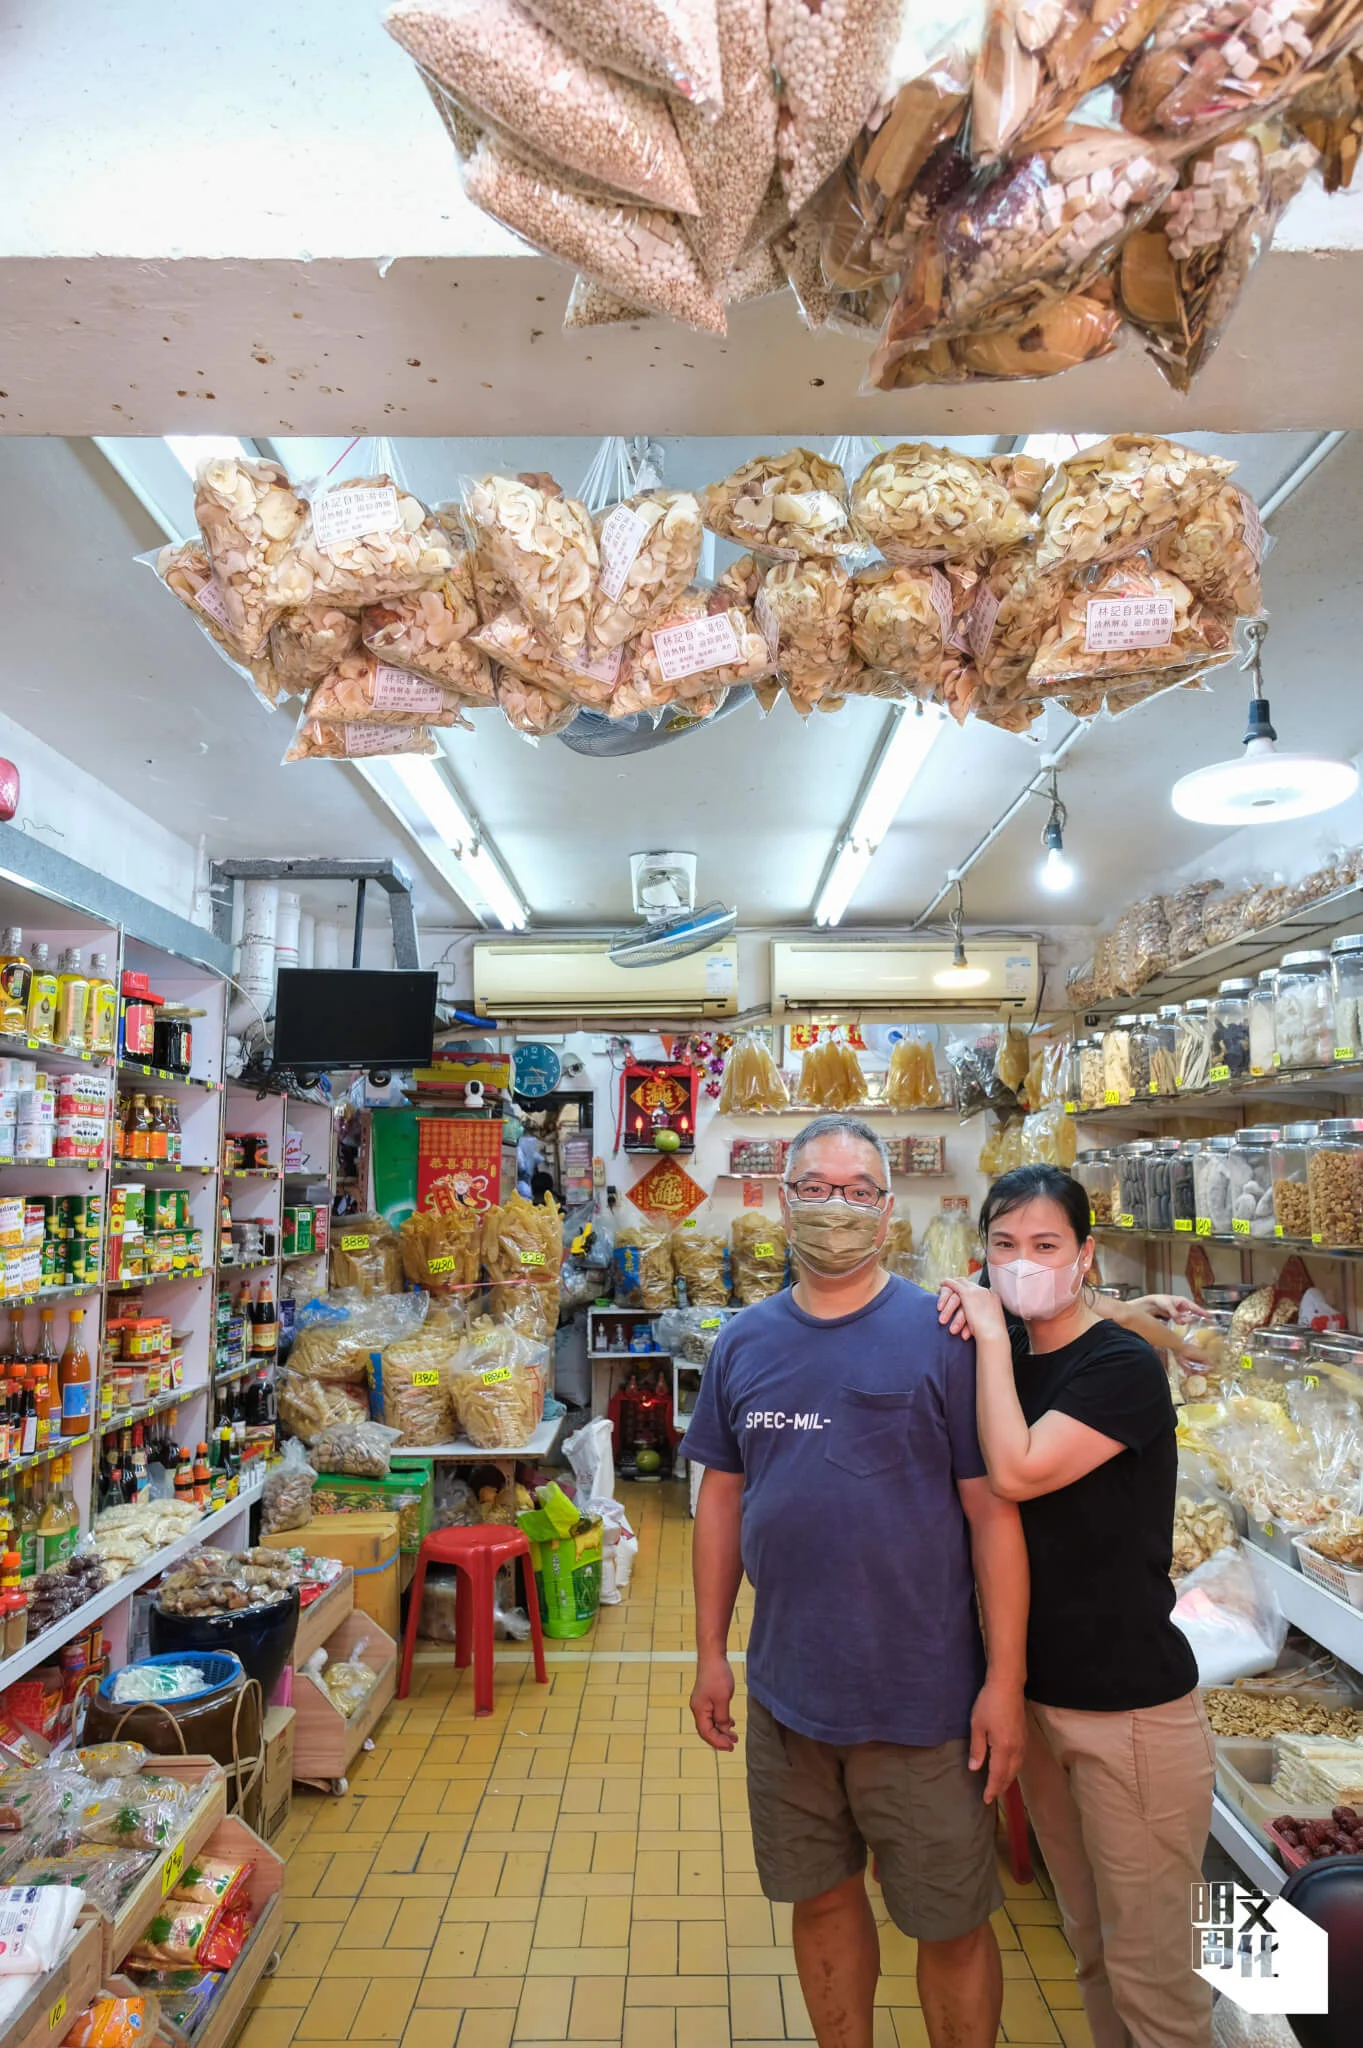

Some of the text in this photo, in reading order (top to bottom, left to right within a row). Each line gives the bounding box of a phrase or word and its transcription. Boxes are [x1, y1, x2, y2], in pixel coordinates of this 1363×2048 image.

[1098, 603, 1168, 618] 林記自製湯包
[745, 1410, 832, 1430] SPEC-MIL-
